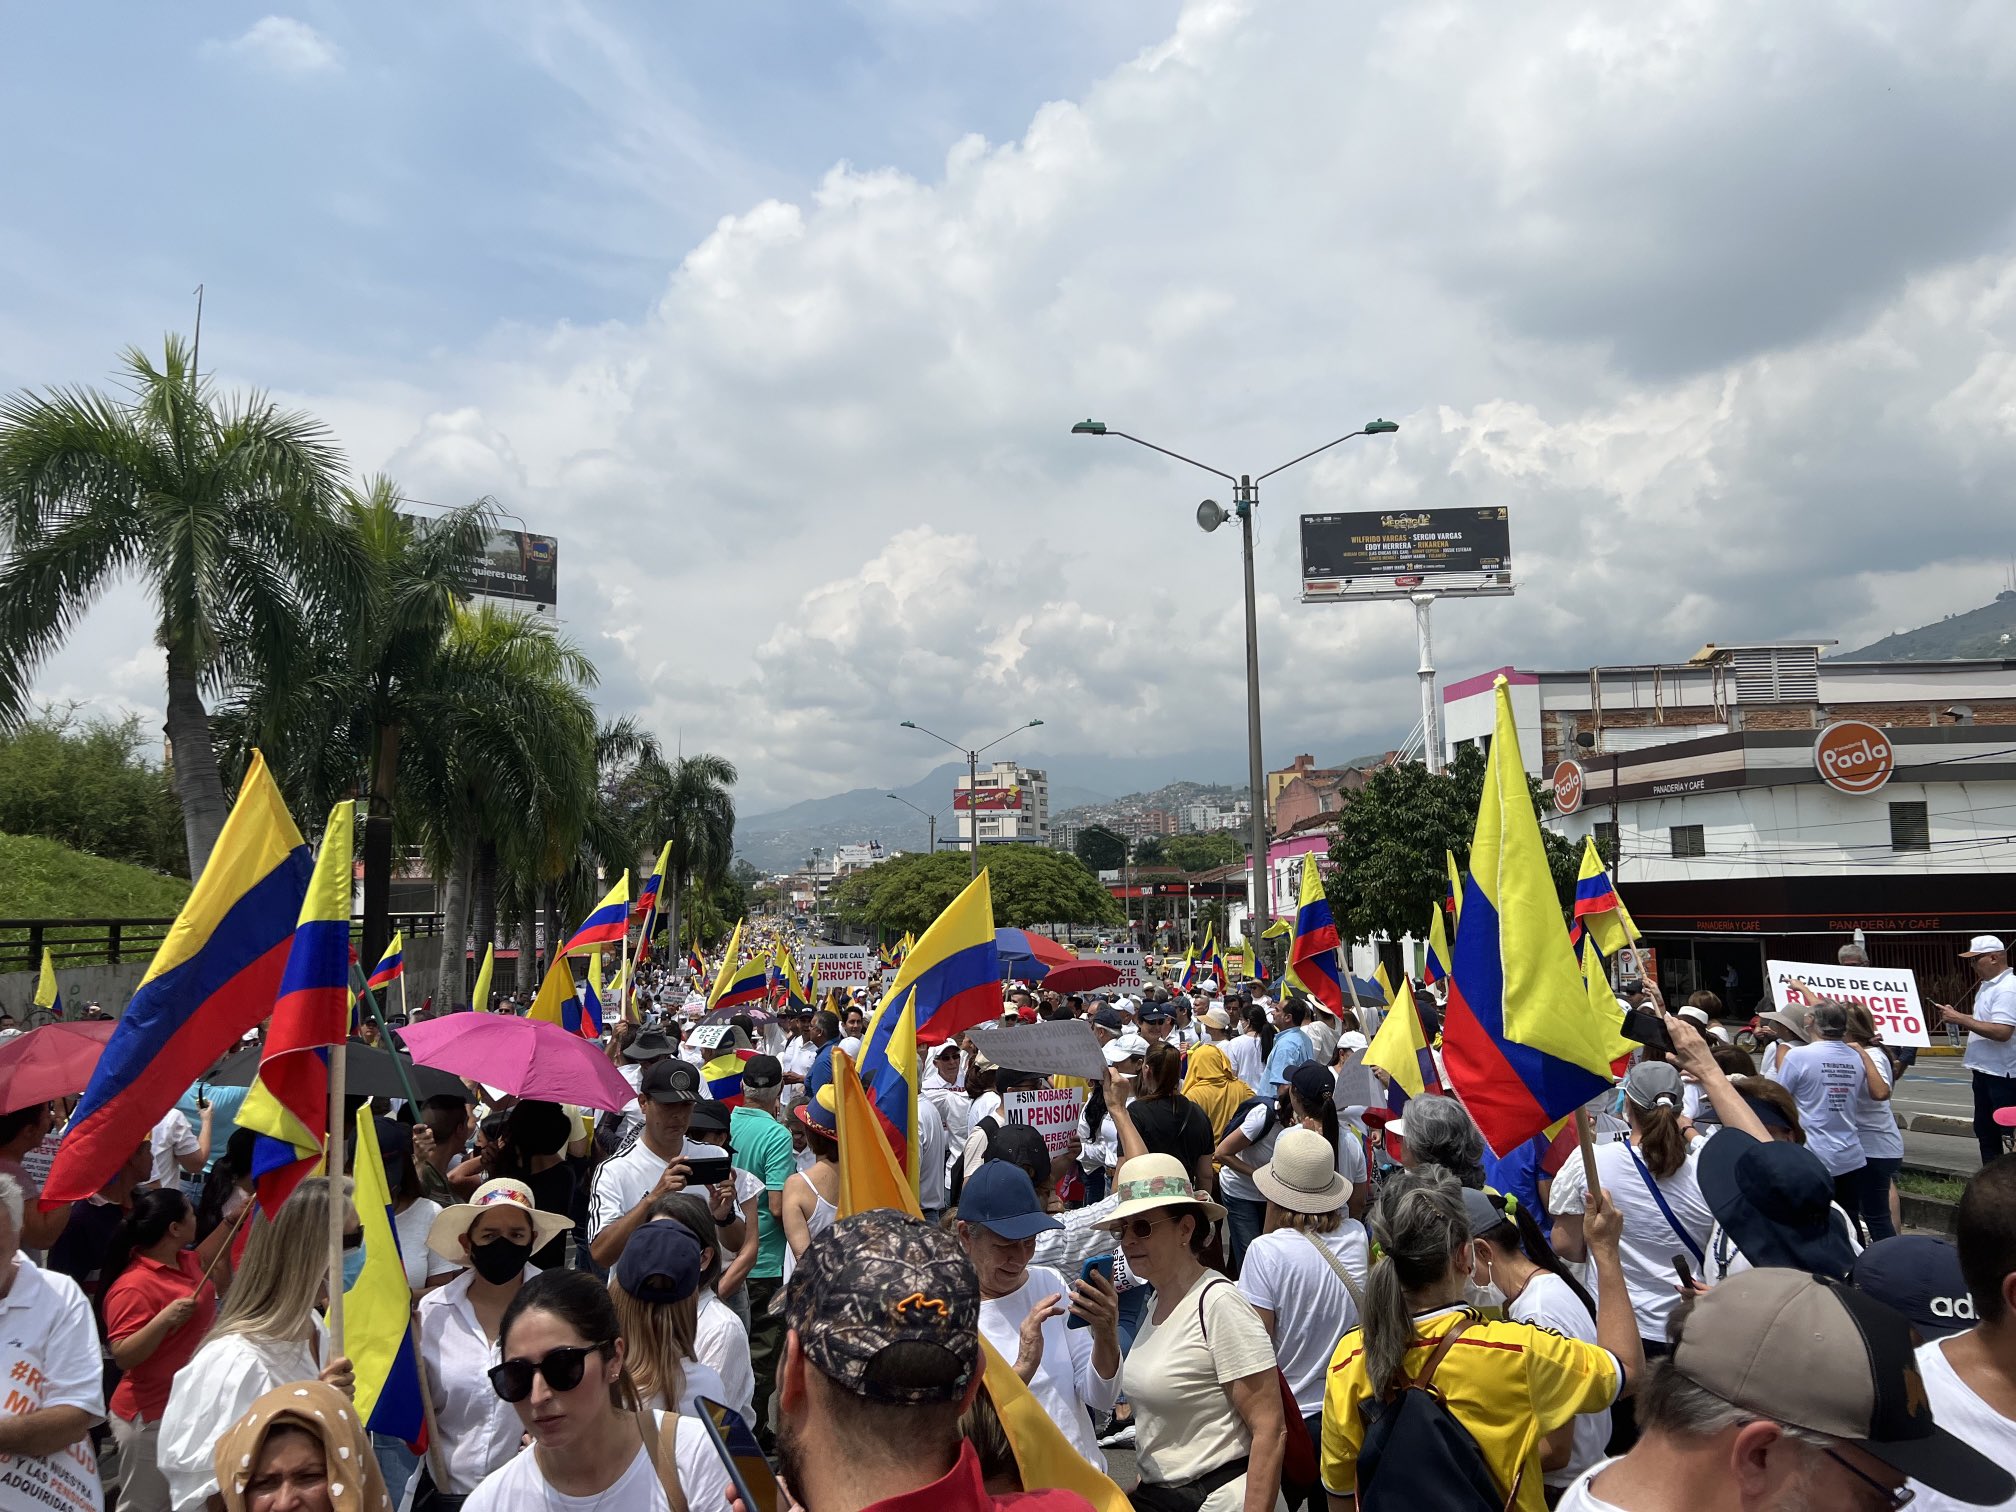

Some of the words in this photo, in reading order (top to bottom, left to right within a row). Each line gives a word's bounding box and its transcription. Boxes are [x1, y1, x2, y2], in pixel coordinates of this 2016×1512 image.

[1351, 535, 1381, 544] WILFRIDO
[1382, 534, 1407, 542] VARGAS
[1412, 533, 1436, 541] SERGIO
[1437, 532, 1462, 540] VARGAS
[1365, 543, 1382, 551] EDDY
[1383, 542, 1412, 550] HERRERA
[472, 567, 506, 579] quieres
[506, 572, 529, 582] usar.
[1822, 739, 1888, 777] Paola
[1653, 782, 1684, 795] PANADERÍA
[1684, 782, 1690, 791] Y
[1689, 779, 1705, 791] CAFÉ
[1697, 920, 1734, 931] PANADERÍA
[1742, 920, 1761, 931] CAFÉ
[1829, 919, 1896, 930] PANADERÍA
[1899, 920, 1906, 929] Y
[1908, 918, 1940, 929] CAFÉ
[1849, 979, 1870, 991] DE
[1873, 980, 1909, 993] CALI
[1016, 1091, 1036, 1104] #SIN
[1037, 1088, 1073, 1102] ROBARSE
[1008, 1108, 1023, 1125] MI
[1027, 1100, 1080, 1126] PENSIÓN
[26, 1463, 49, 1484] LAS
